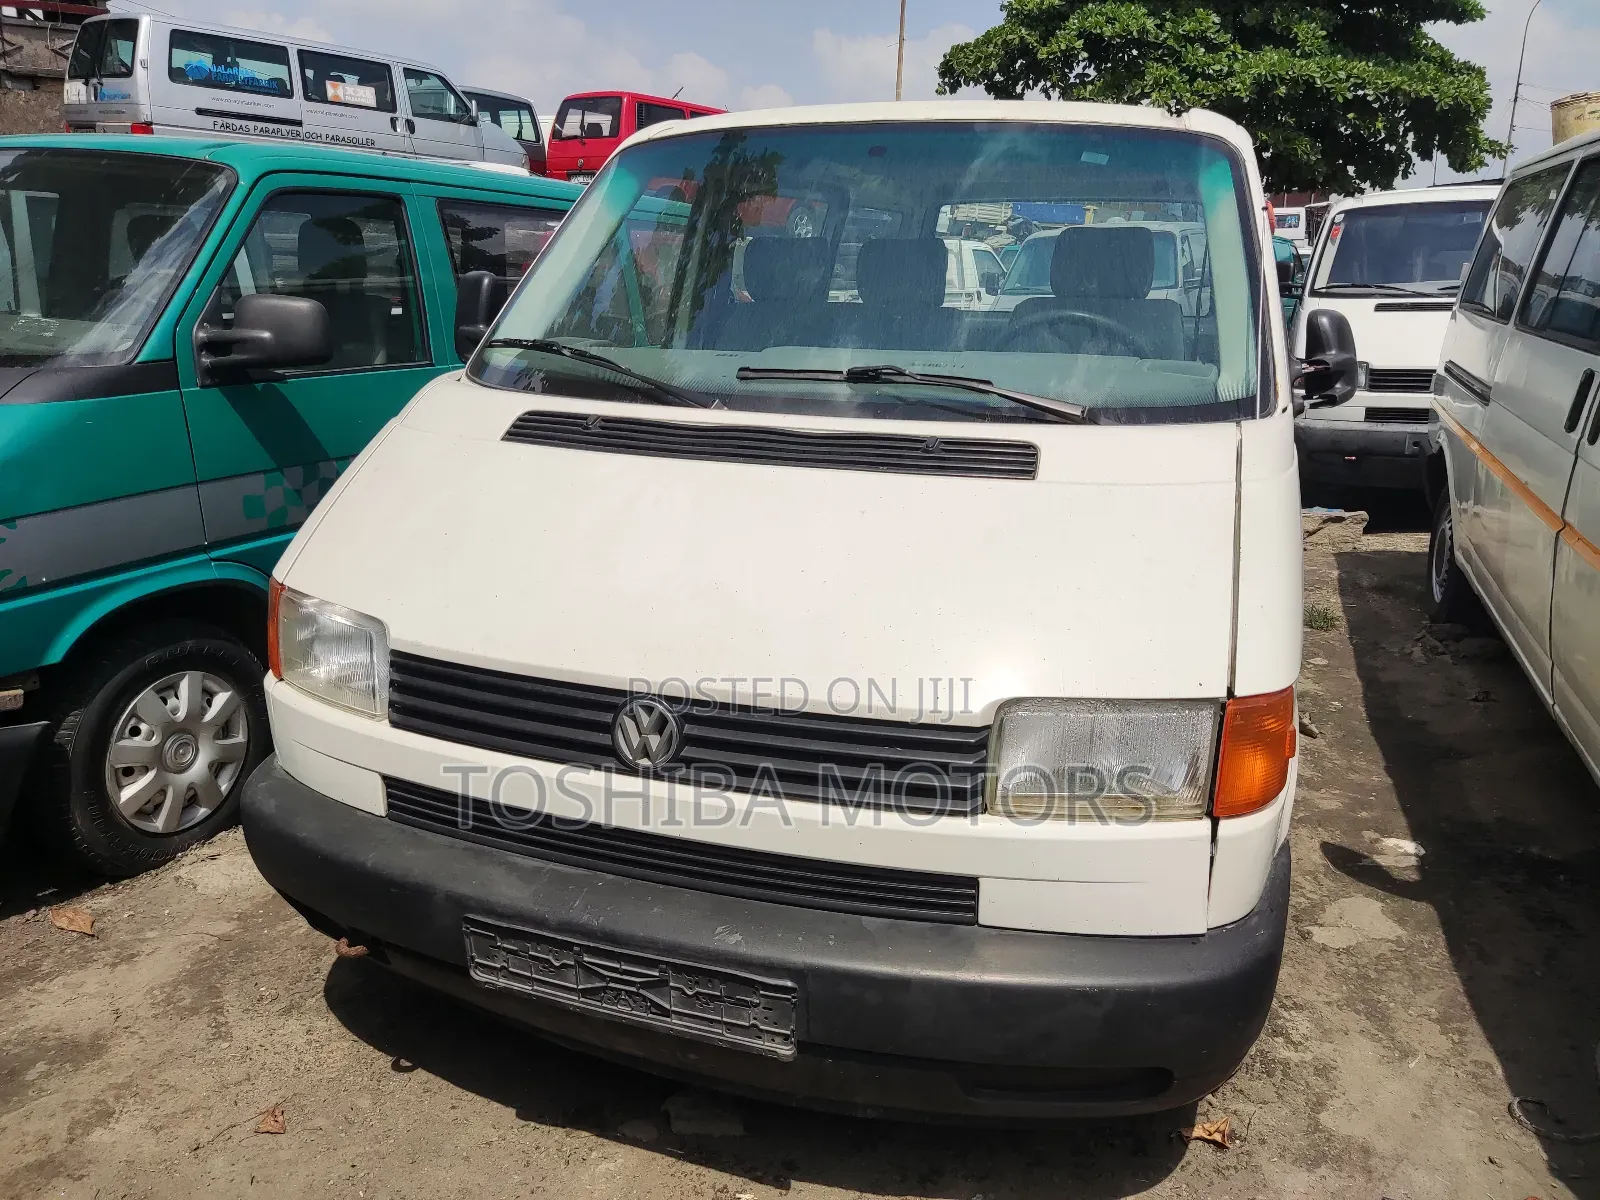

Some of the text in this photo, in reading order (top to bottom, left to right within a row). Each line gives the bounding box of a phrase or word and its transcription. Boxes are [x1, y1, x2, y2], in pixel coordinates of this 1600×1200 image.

[212, 120, 376, 147] FÄRDAS PARAPLYER OCH PARASOLLER
